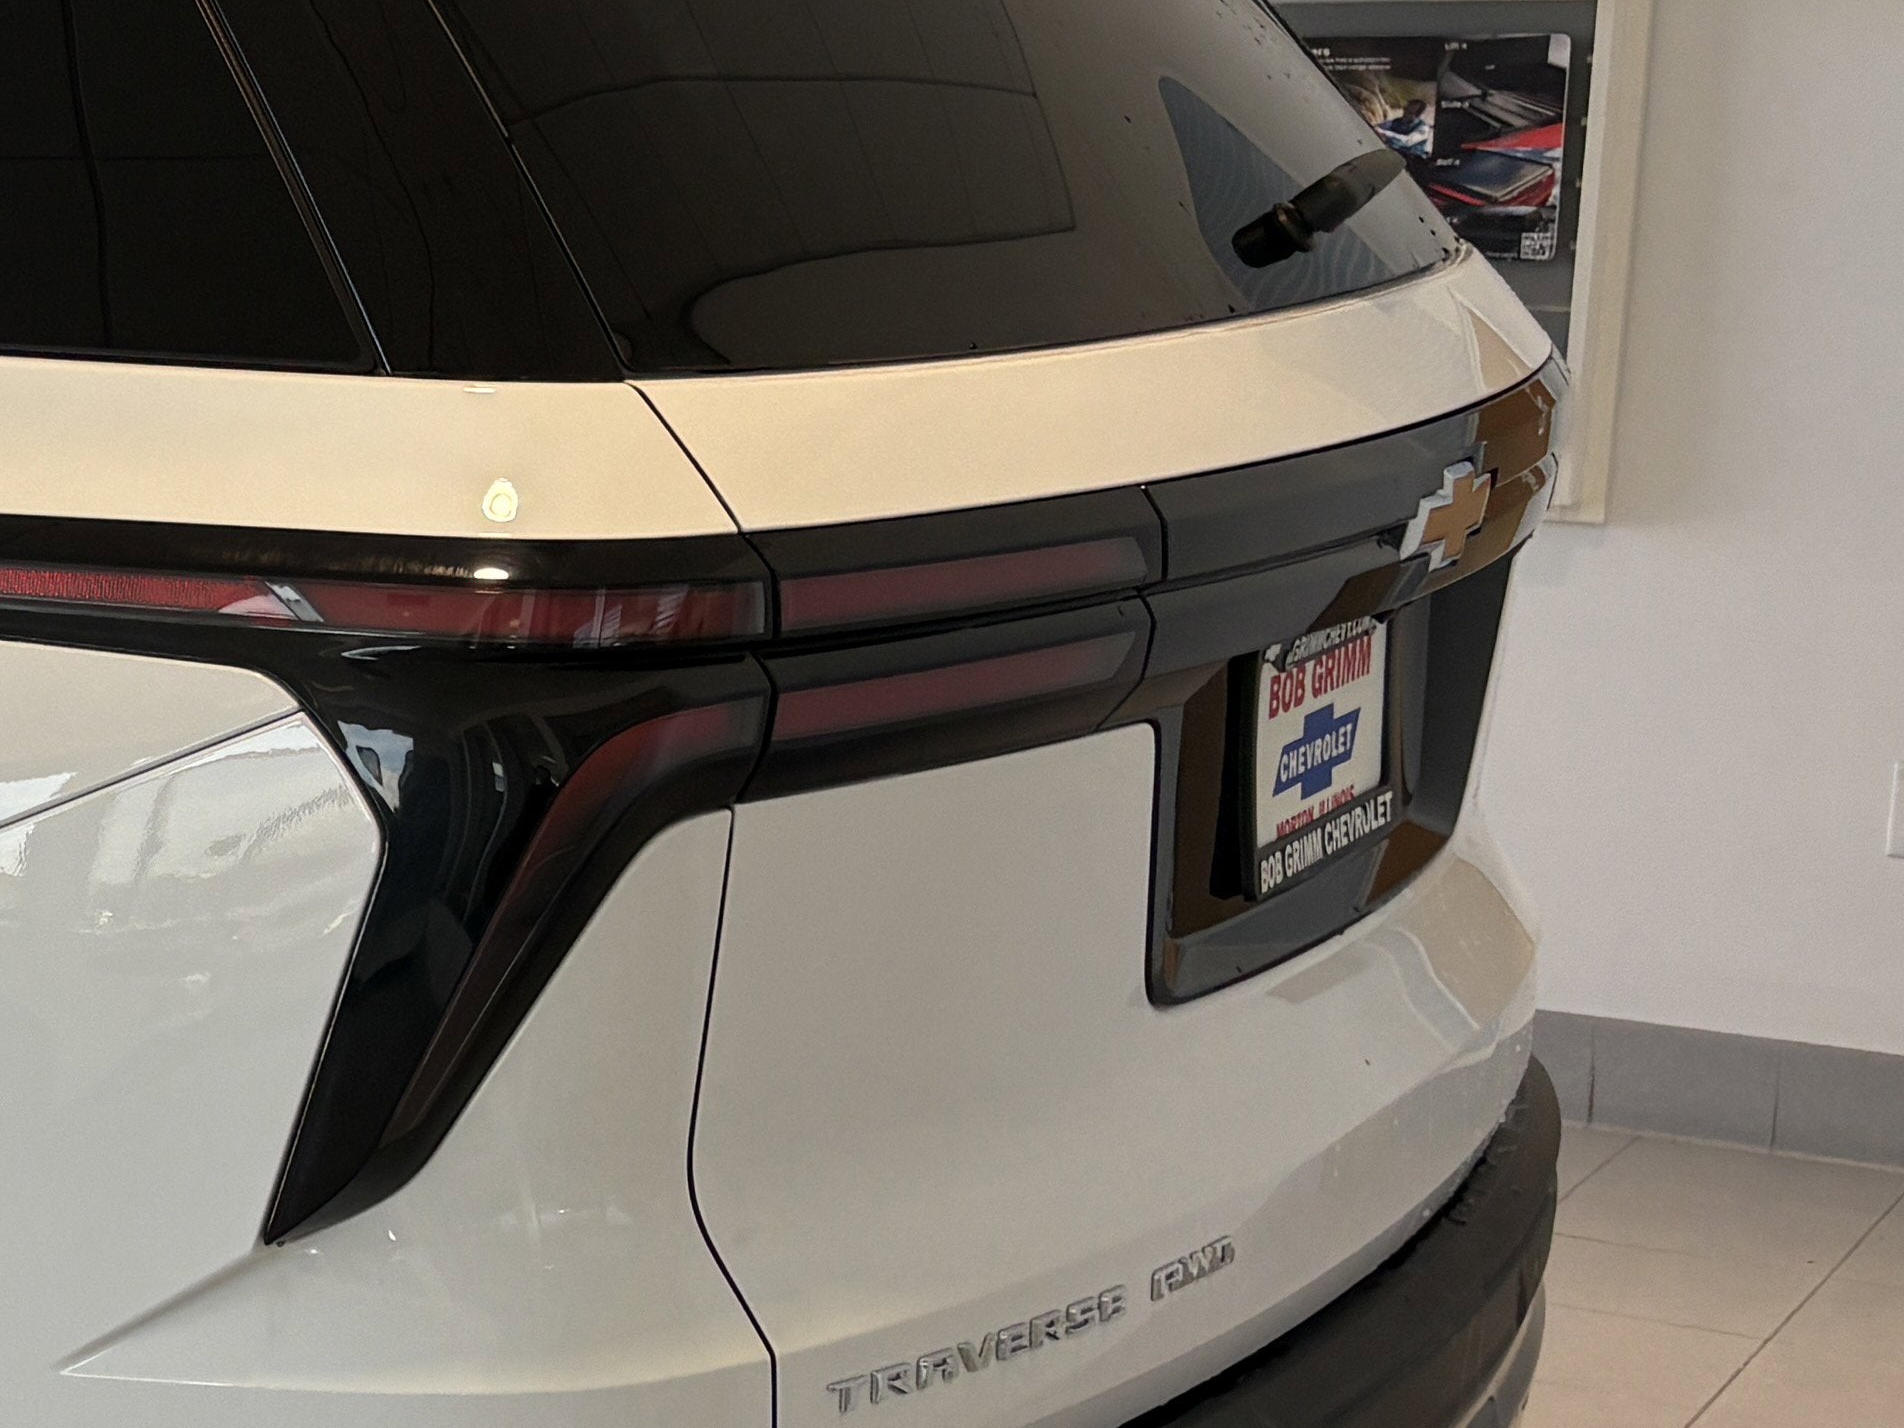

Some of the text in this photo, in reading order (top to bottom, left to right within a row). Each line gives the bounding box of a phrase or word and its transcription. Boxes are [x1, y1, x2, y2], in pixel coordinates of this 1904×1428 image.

[1269, 634, 1372, 720] BOB GRIMM
[1280, 723, 1353, 783] CHEVROLET
[1260, 790, 1393, 894] BOB GRIMM CHEVROLET
[826, 1283, 1128, 1414] TRAVERSE
